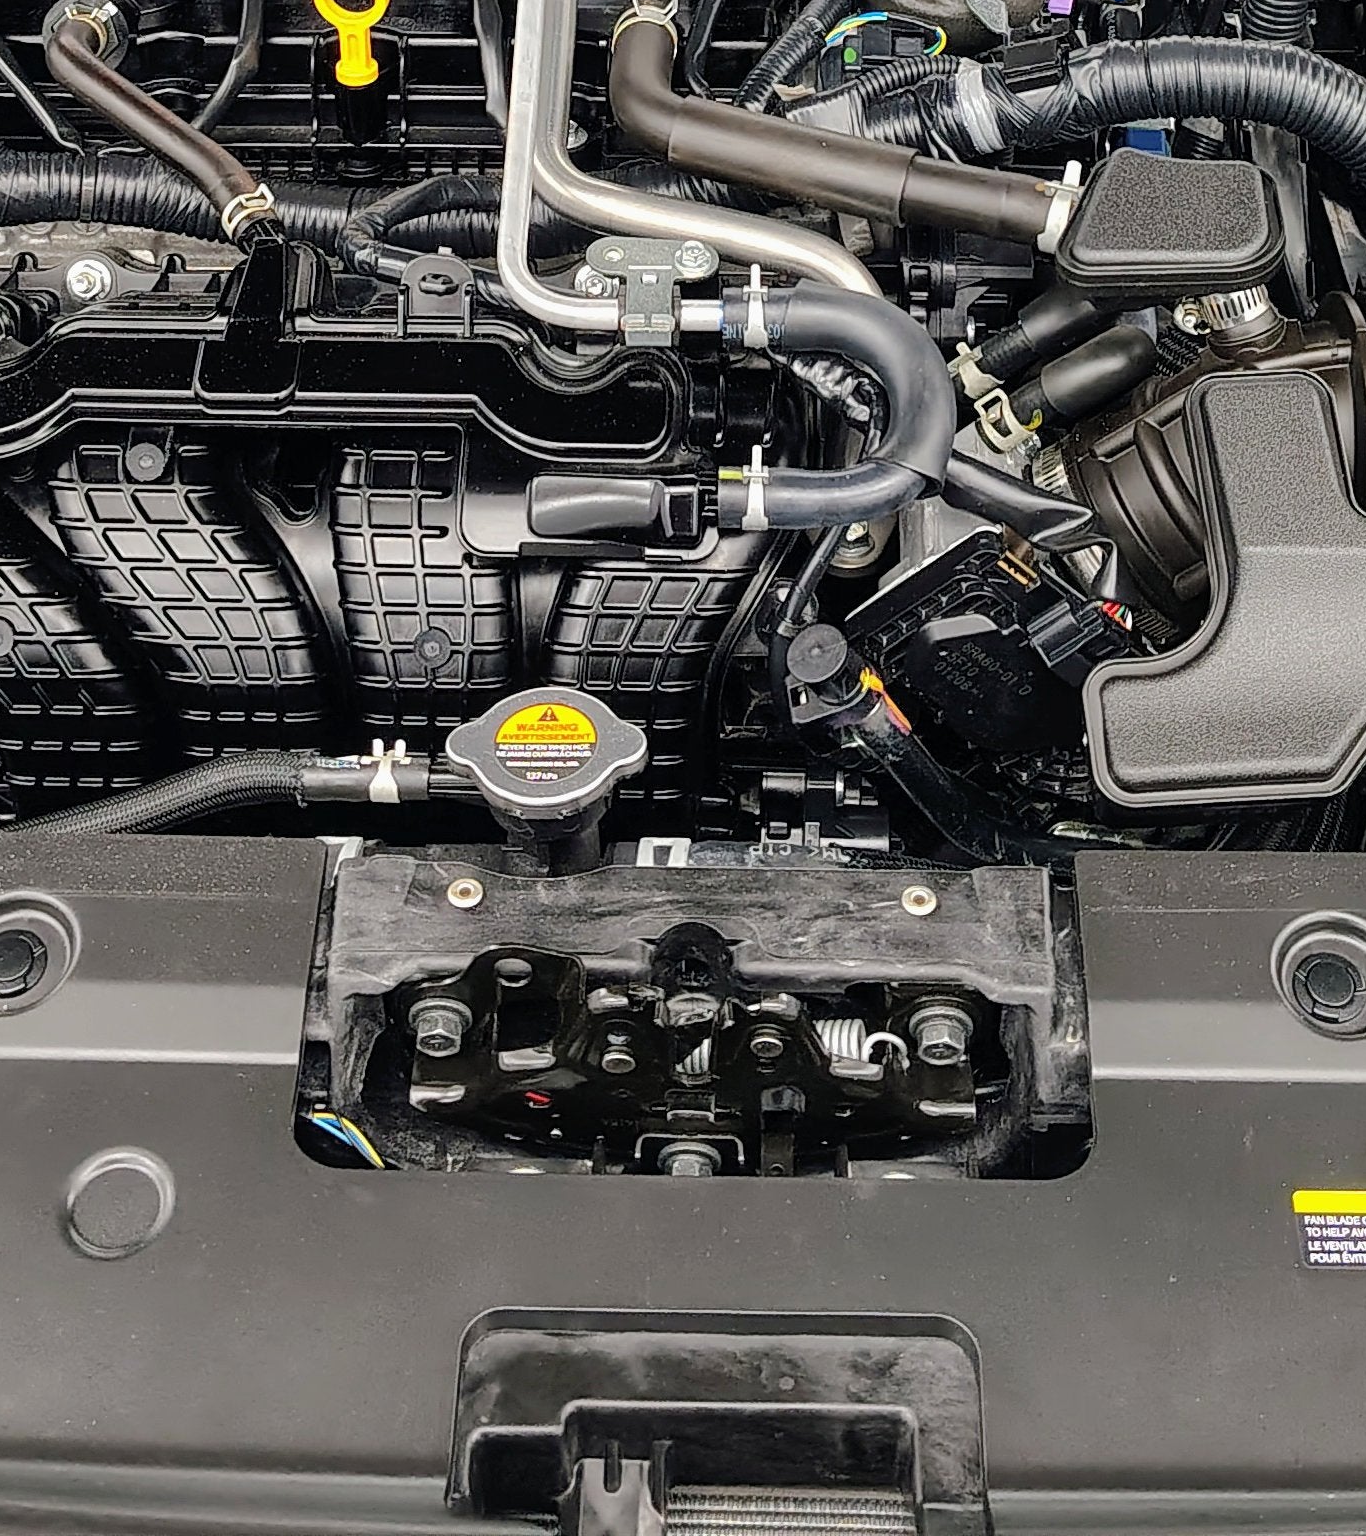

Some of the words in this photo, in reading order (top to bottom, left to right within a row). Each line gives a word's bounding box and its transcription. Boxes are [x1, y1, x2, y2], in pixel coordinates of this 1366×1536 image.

[516, 723, 579, 732] WARNING
[501, 733, 591, 741] AVERTISSEMENT
[1304, 1215, 1325, 1226] FAN
[1326, 1215, 1360, 1226] BLADE
[1305, 1227, 1321, 1238] TO
[1323, 1227, 1350, 1238] HELP
[1308, 1240, 1322, 1251] LE
[1310, 1252, 1341, 1264] POUR
